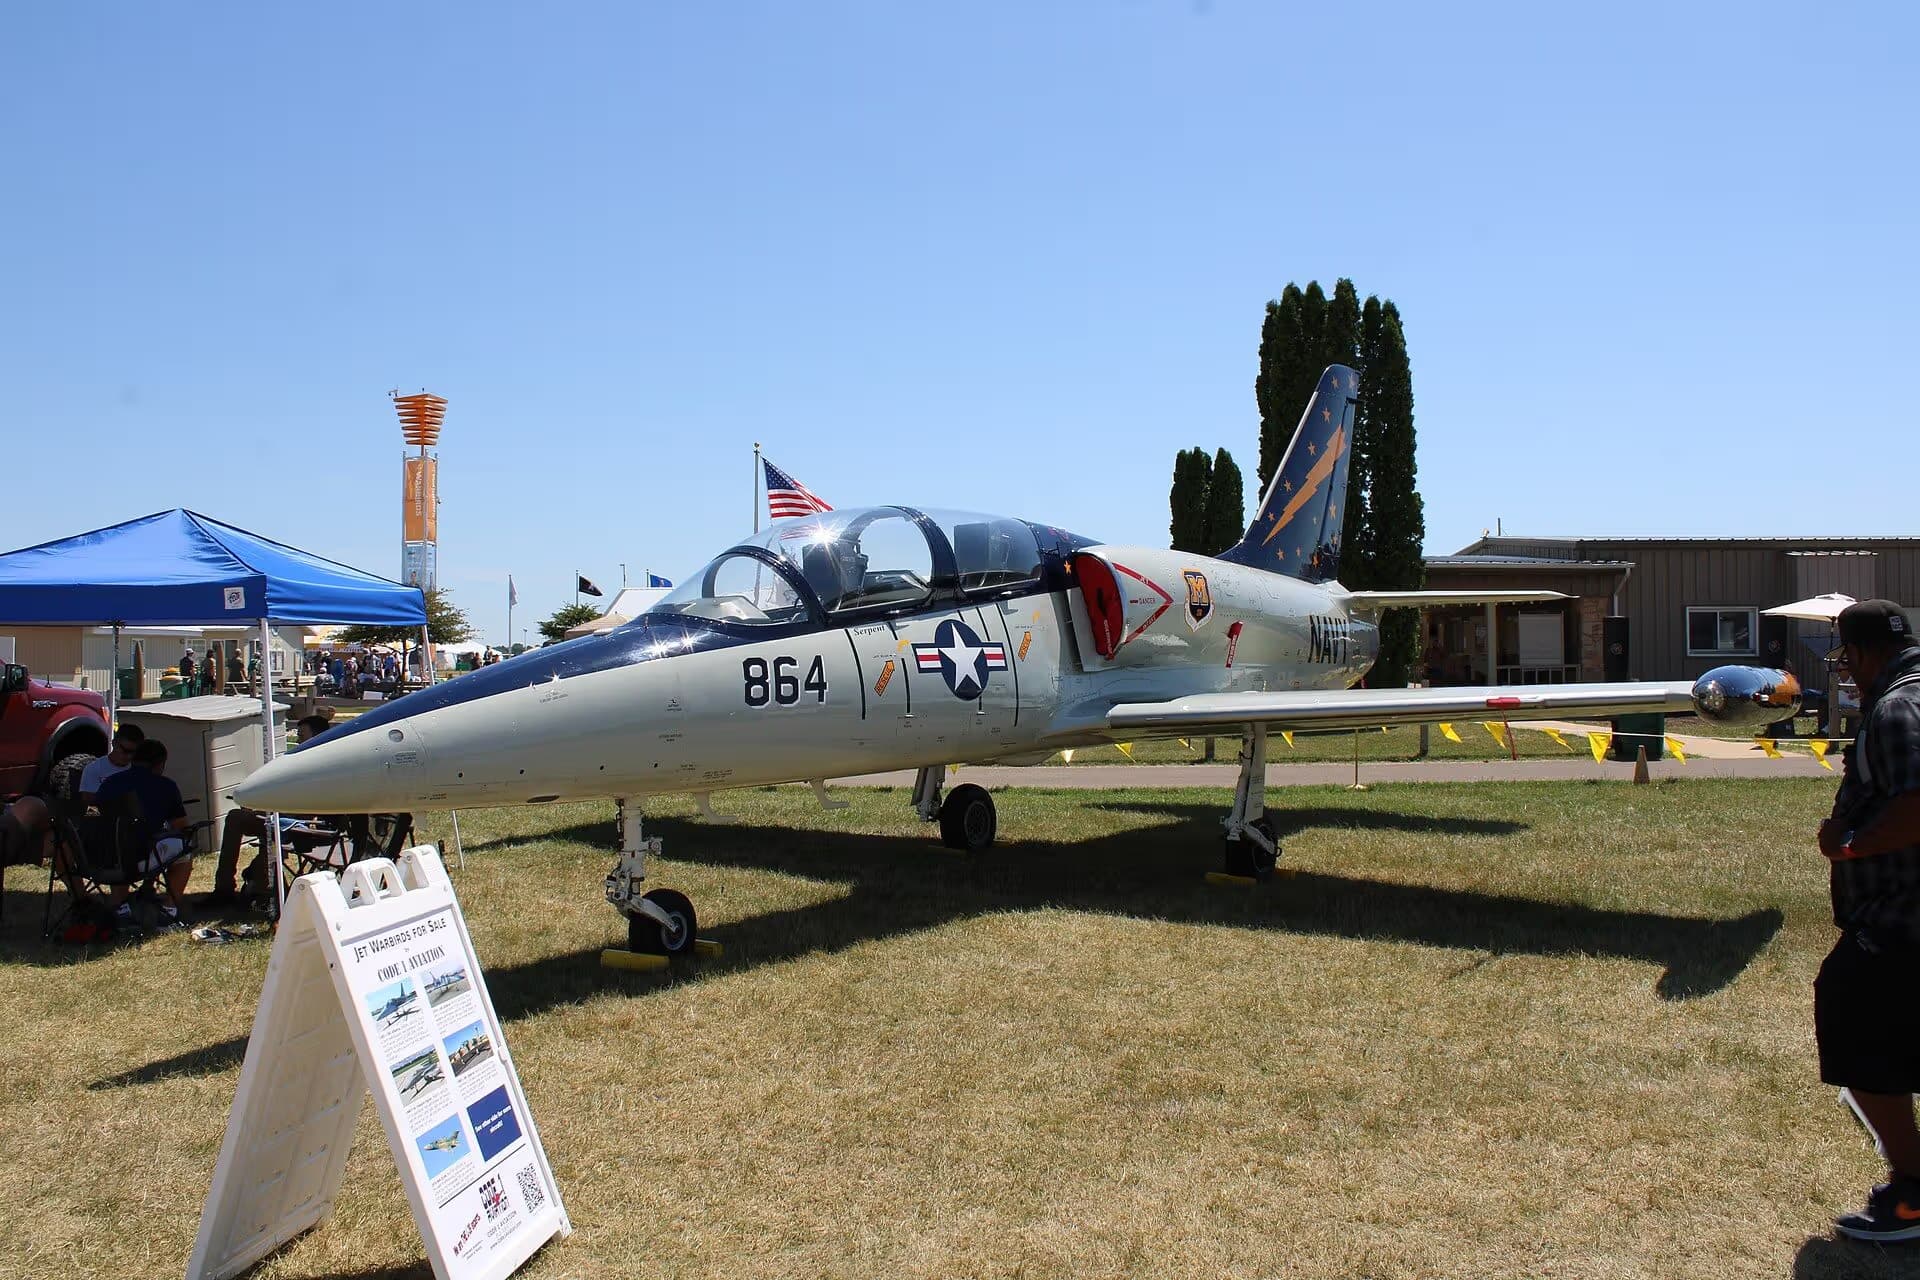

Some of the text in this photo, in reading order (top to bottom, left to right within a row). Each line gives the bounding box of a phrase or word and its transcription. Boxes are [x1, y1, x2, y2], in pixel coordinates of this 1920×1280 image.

[853, 625, 886, 637] Serpent
[1307, 614, 1347, 664] NAVY
[742, 655, 828, 708] 864
[377, 962, 401, 982] CODE
[408, 944, 445, 970] AVIATION
